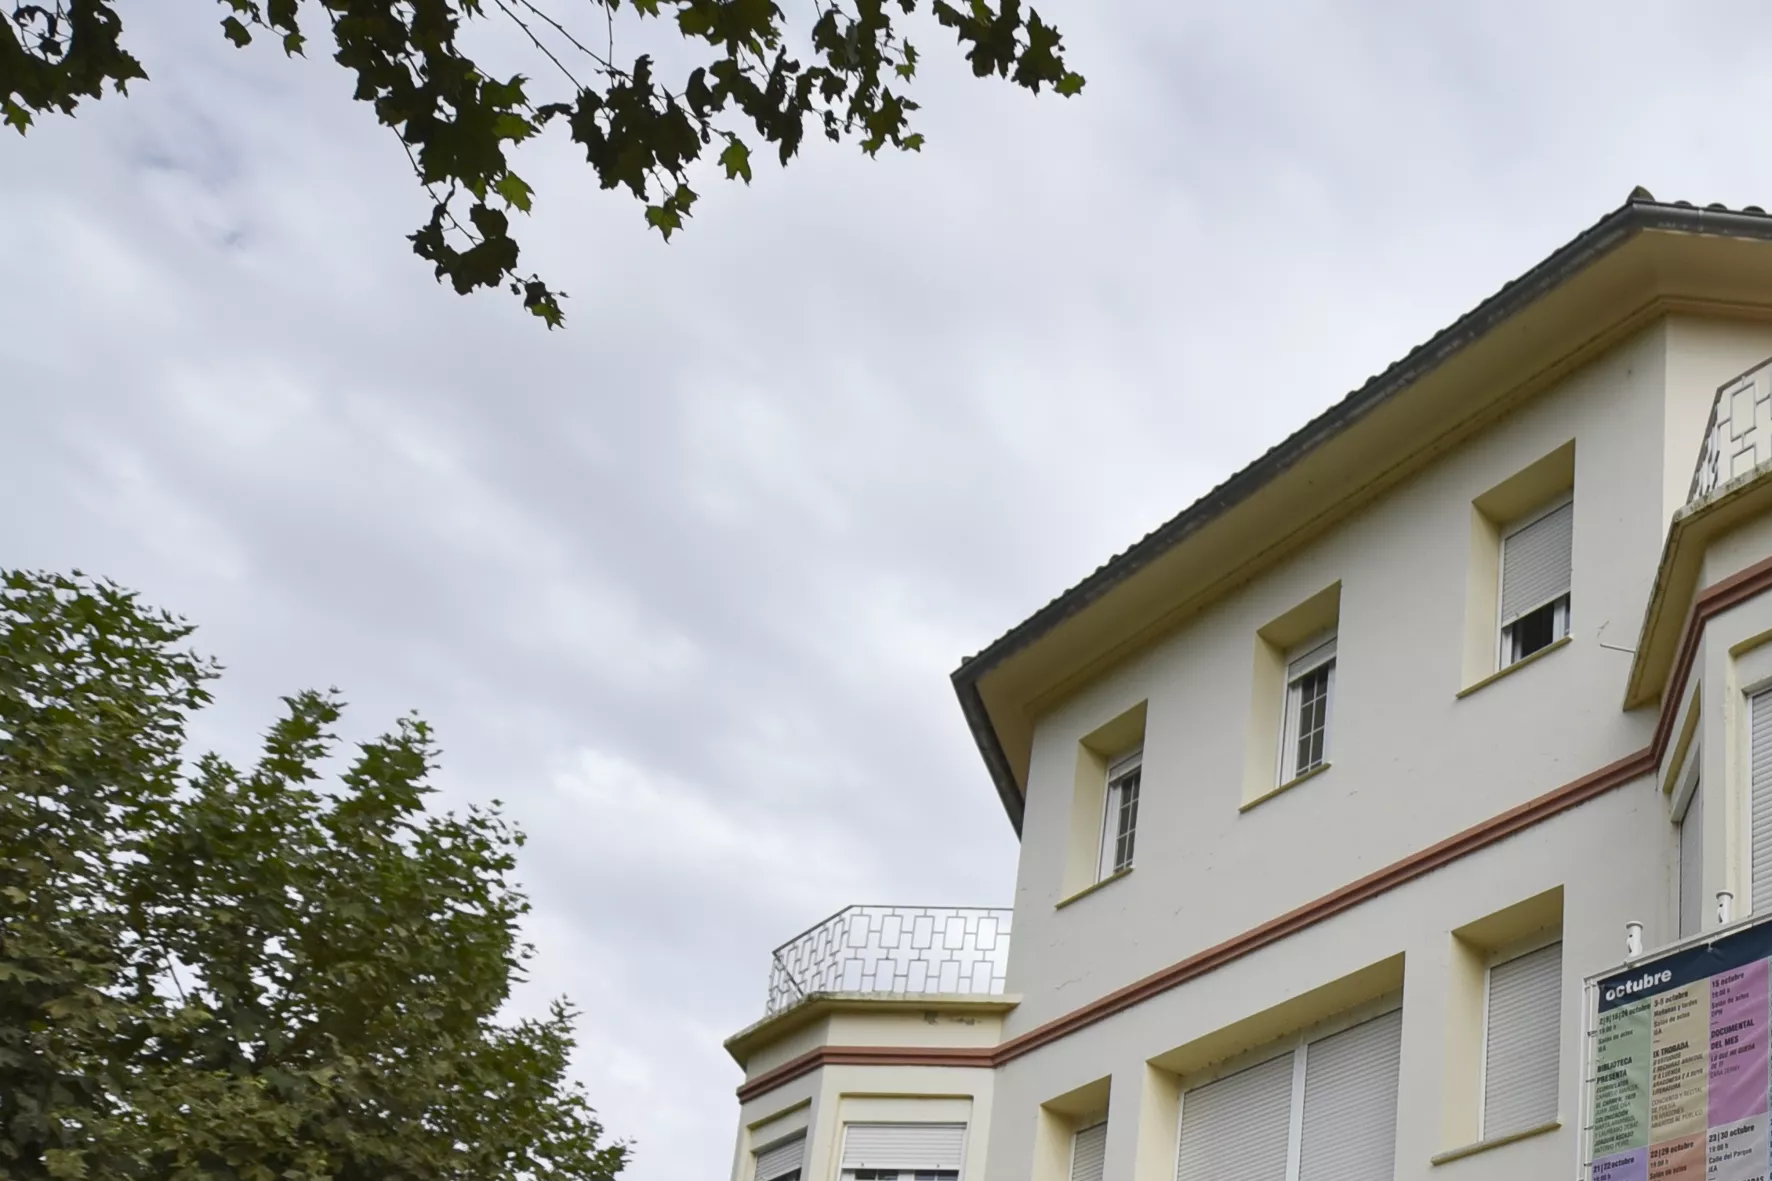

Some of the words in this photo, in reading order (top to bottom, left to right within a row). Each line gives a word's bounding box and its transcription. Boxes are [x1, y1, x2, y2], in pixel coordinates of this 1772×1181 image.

[1606, 969, 1671, 1000] octubre
[1712, 980, 1719, 988] 15
[1721, 973, 1744, 985] octubre
[1665, 991, 1688, 1003] octubre
[1629, 1004, 1651, 1015] octubre
[1711, 1020, 1754, 1038] DOCUMENTAL
[1711, 1041, 1722, 1050] DEL
[1725, 1036, 1738, 1046] MES
[1598, 1057, 1632, 1072] BIBLIOTECA
[1597, 1070, 1626, 1084] PRESENTA
[1730, 1125, 1754, 1136] octubre
[1671, 1142, 1693, 1153] octubre
[1612, 1157, 1634, 1168] octubre
[1709, 1156, 1722, 1164] Calle
[1734, 1148, 1752, 1157] Parque
